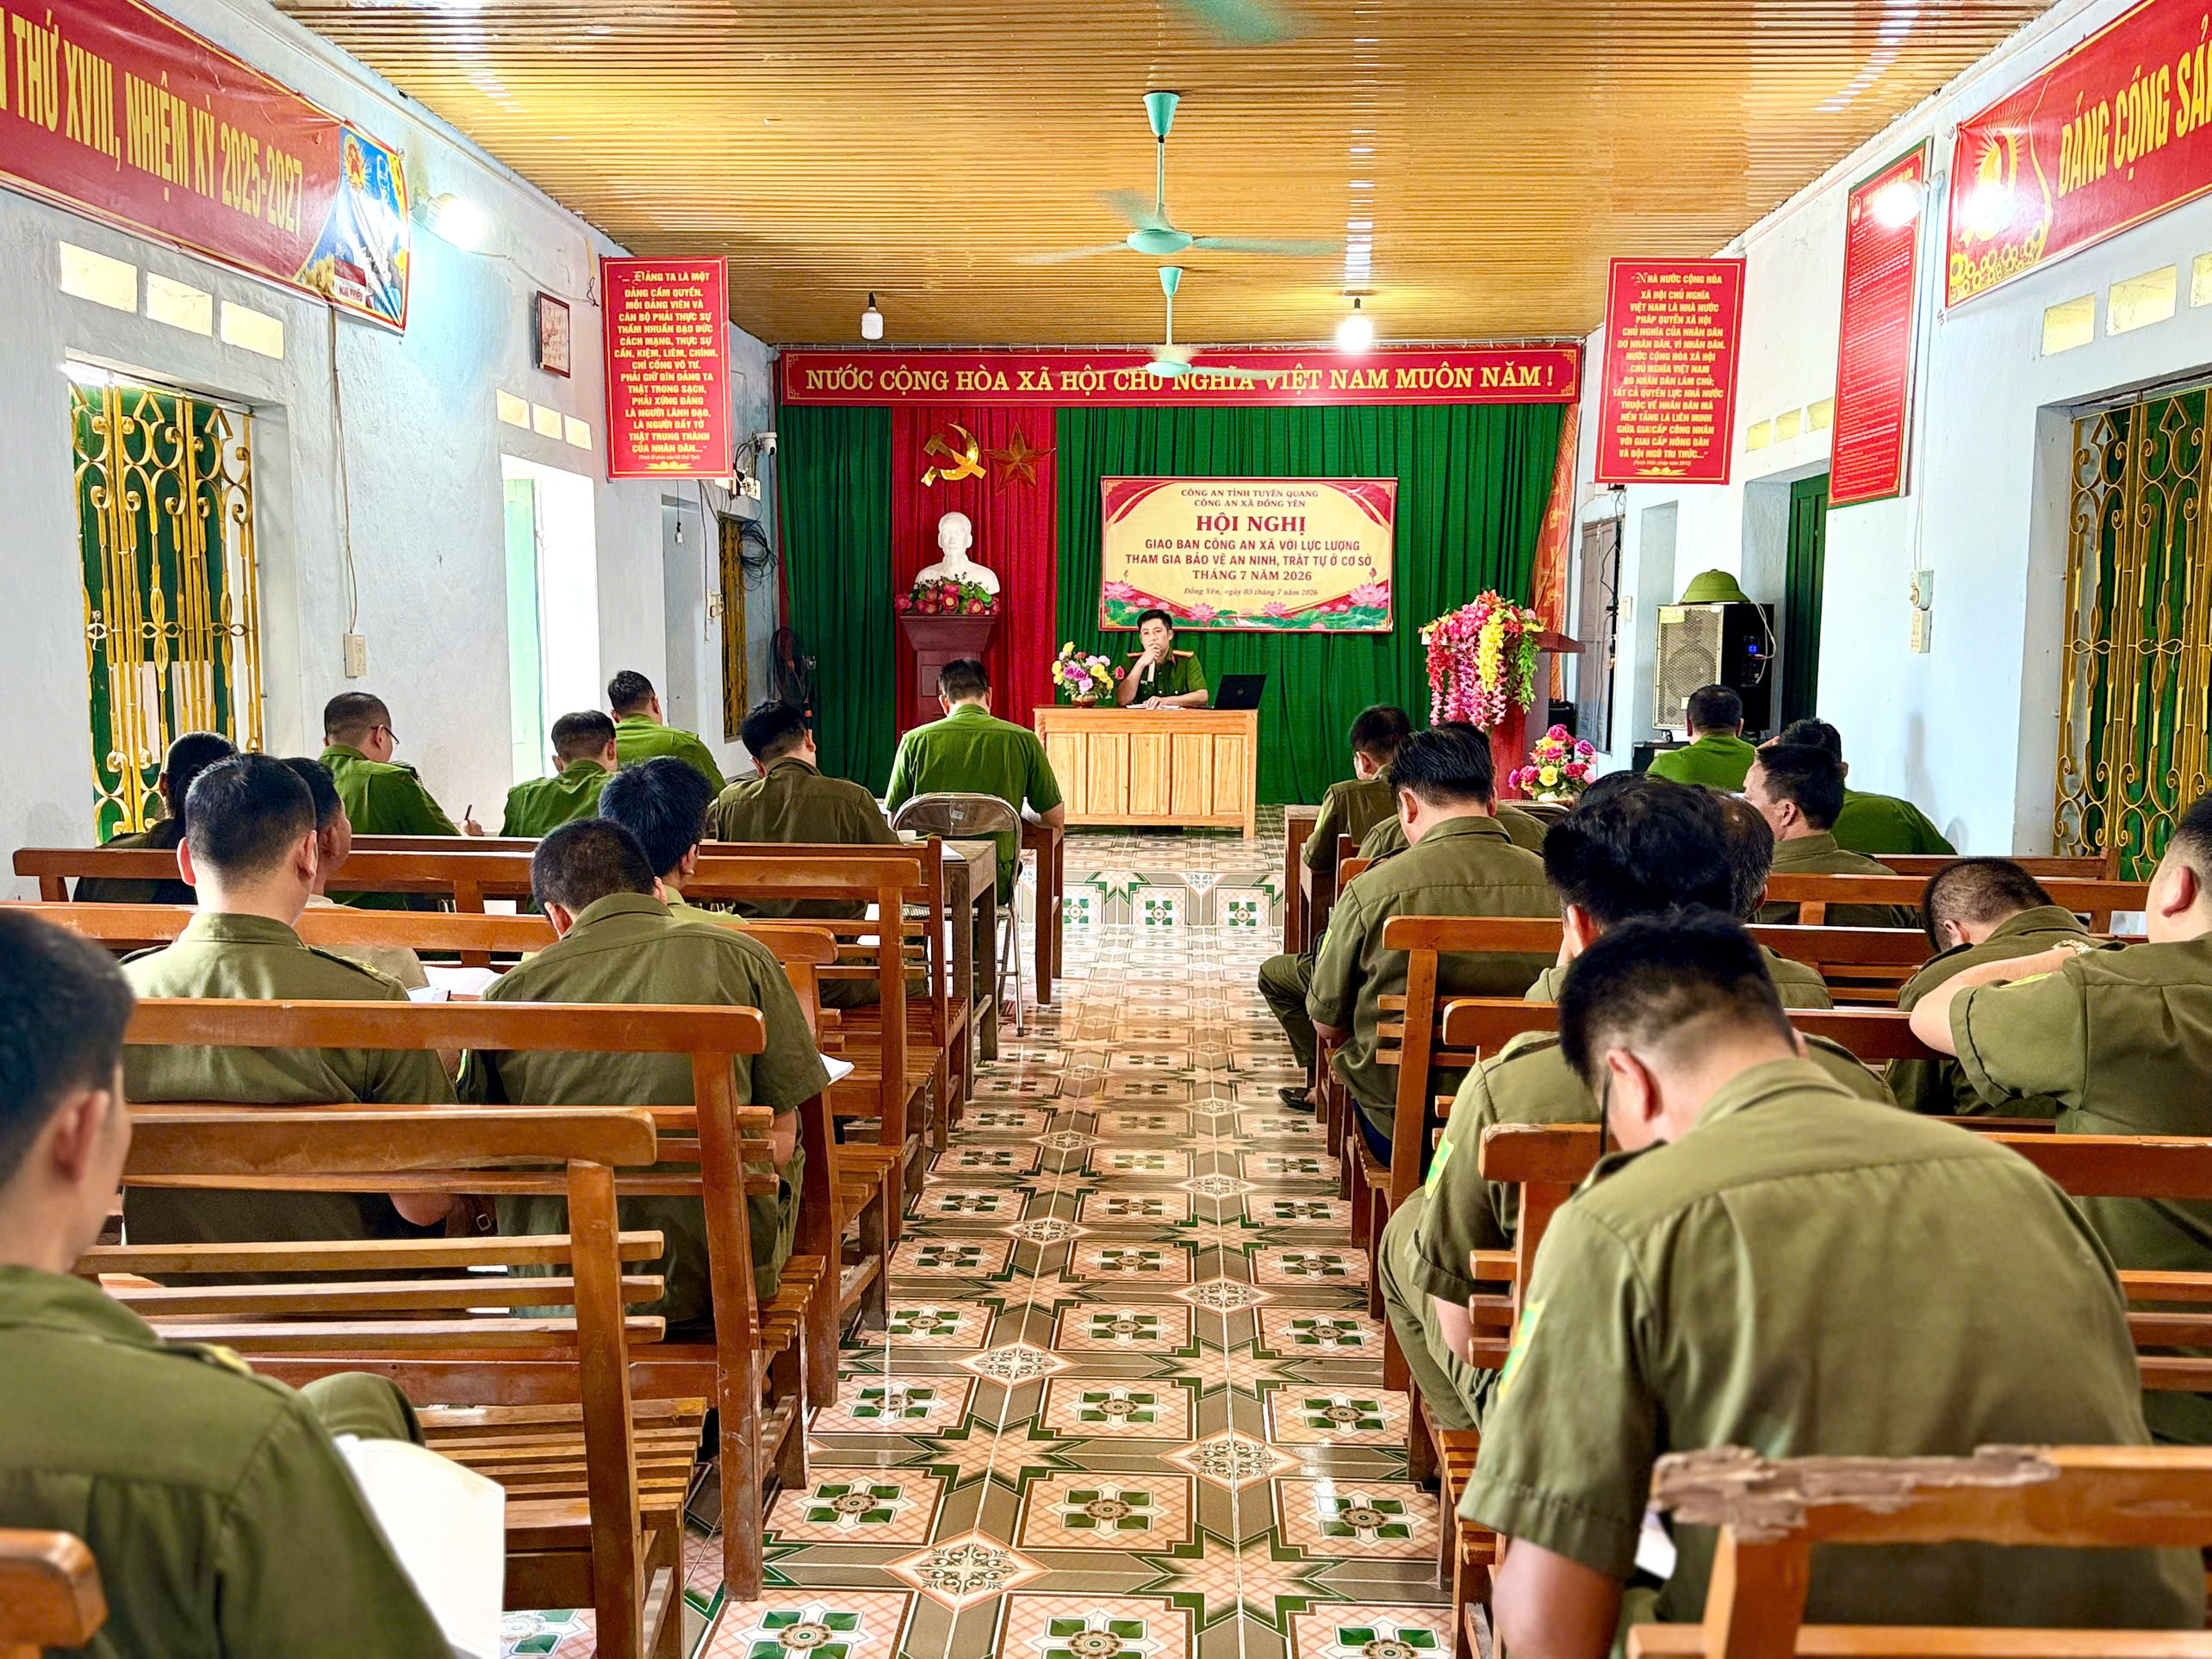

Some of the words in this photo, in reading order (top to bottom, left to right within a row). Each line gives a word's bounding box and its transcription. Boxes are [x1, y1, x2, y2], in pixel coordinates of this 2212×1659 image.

[12, 9, 59, 133] THỨ
[63, 39, 121, 172] XVIII,
[125, 70, 190, 202] NHIỆM
[192, 94, 215, 201] KỲ
[221, 121, 304, 239] 2025-2027
[2058, 90, 2110, 199] ĐẢNG
[2113, 65, 2171, 182] CỘNG
[665, 273, 676, 282] TA
[678, 272, 689, 282] LÀ
[691, 271, 710, 283] MỘT
[624, 287, 648, 297] ĐẢNG
[644, 298, 668, 309] ĐẢNG
[692, 299, 703, 308] VÀ
[618, 312, 637, 321] CÁN
[639, 312, 650, 323] BỘ
[653, 311, 673, 321] PHẢI
[674, 313, 697, 323] THỰC
[699, 312, 712, 322] SỰ
[806, 363, 873, 390] NƯỚC
[879, 364, 949, 396] CỘNG
[956, 363, 1010, 391] HÒA
[1017, 365, 1053, 391] XÃ
[1060, 364, 1105, 396] HỘI
[1265, 363, 1323, 395] VIỆT
[1329, 369, 1389, 389] NAM
[1395, 362, 1474, 388] MUÔN
[1480, 360, 1543, 388] NĂM
[1547, 366, 1554, 387] !
[1253, 488, 1283, 497] TUYÊN
[1196, 512, 1239, 535] HỘI
[1247, 516, 1306, 536] NGHỊ
[1145, 539, 1172, 549] GIAO
[1177, 540, 1199, 550] BAN
[1204, 537, 1235, 550] CÔNG
[1240, 541, 1255, 550] AN
[1259, 538, 1275, 550] XÃ
[1280, 539, 1297, 550] VỚI
[1302, 541, 1321, 551] LỰC
[1326, 541, 1359, 551] LƯỢNG
[1126, 555, 1158, 564] THAM
[1162, 555, 1181, 564] GIA
[1185, 552, 1209, 564] BẢO
[1213, 553, 1226, 567] VỆ
[1230, 556, 1246, 565] AN
[1249, 556, 1279, 567] NINH,
[1283, 554, 1309, 567] TRẬT
[1313, 556, 1327, 568] TỰ
[1330, 553, 1338, 565] Ở
[1342, 556, 1356, 565] CƠ
[1358, 553, 1371, 566] SỞ
[1192, 568, 1236, 580] THÁNG
[1241, 570, 1246, 580] 7
[1251, 569, 1279, 580] NĂM
[1283, 571, 1312, 581] 2026
